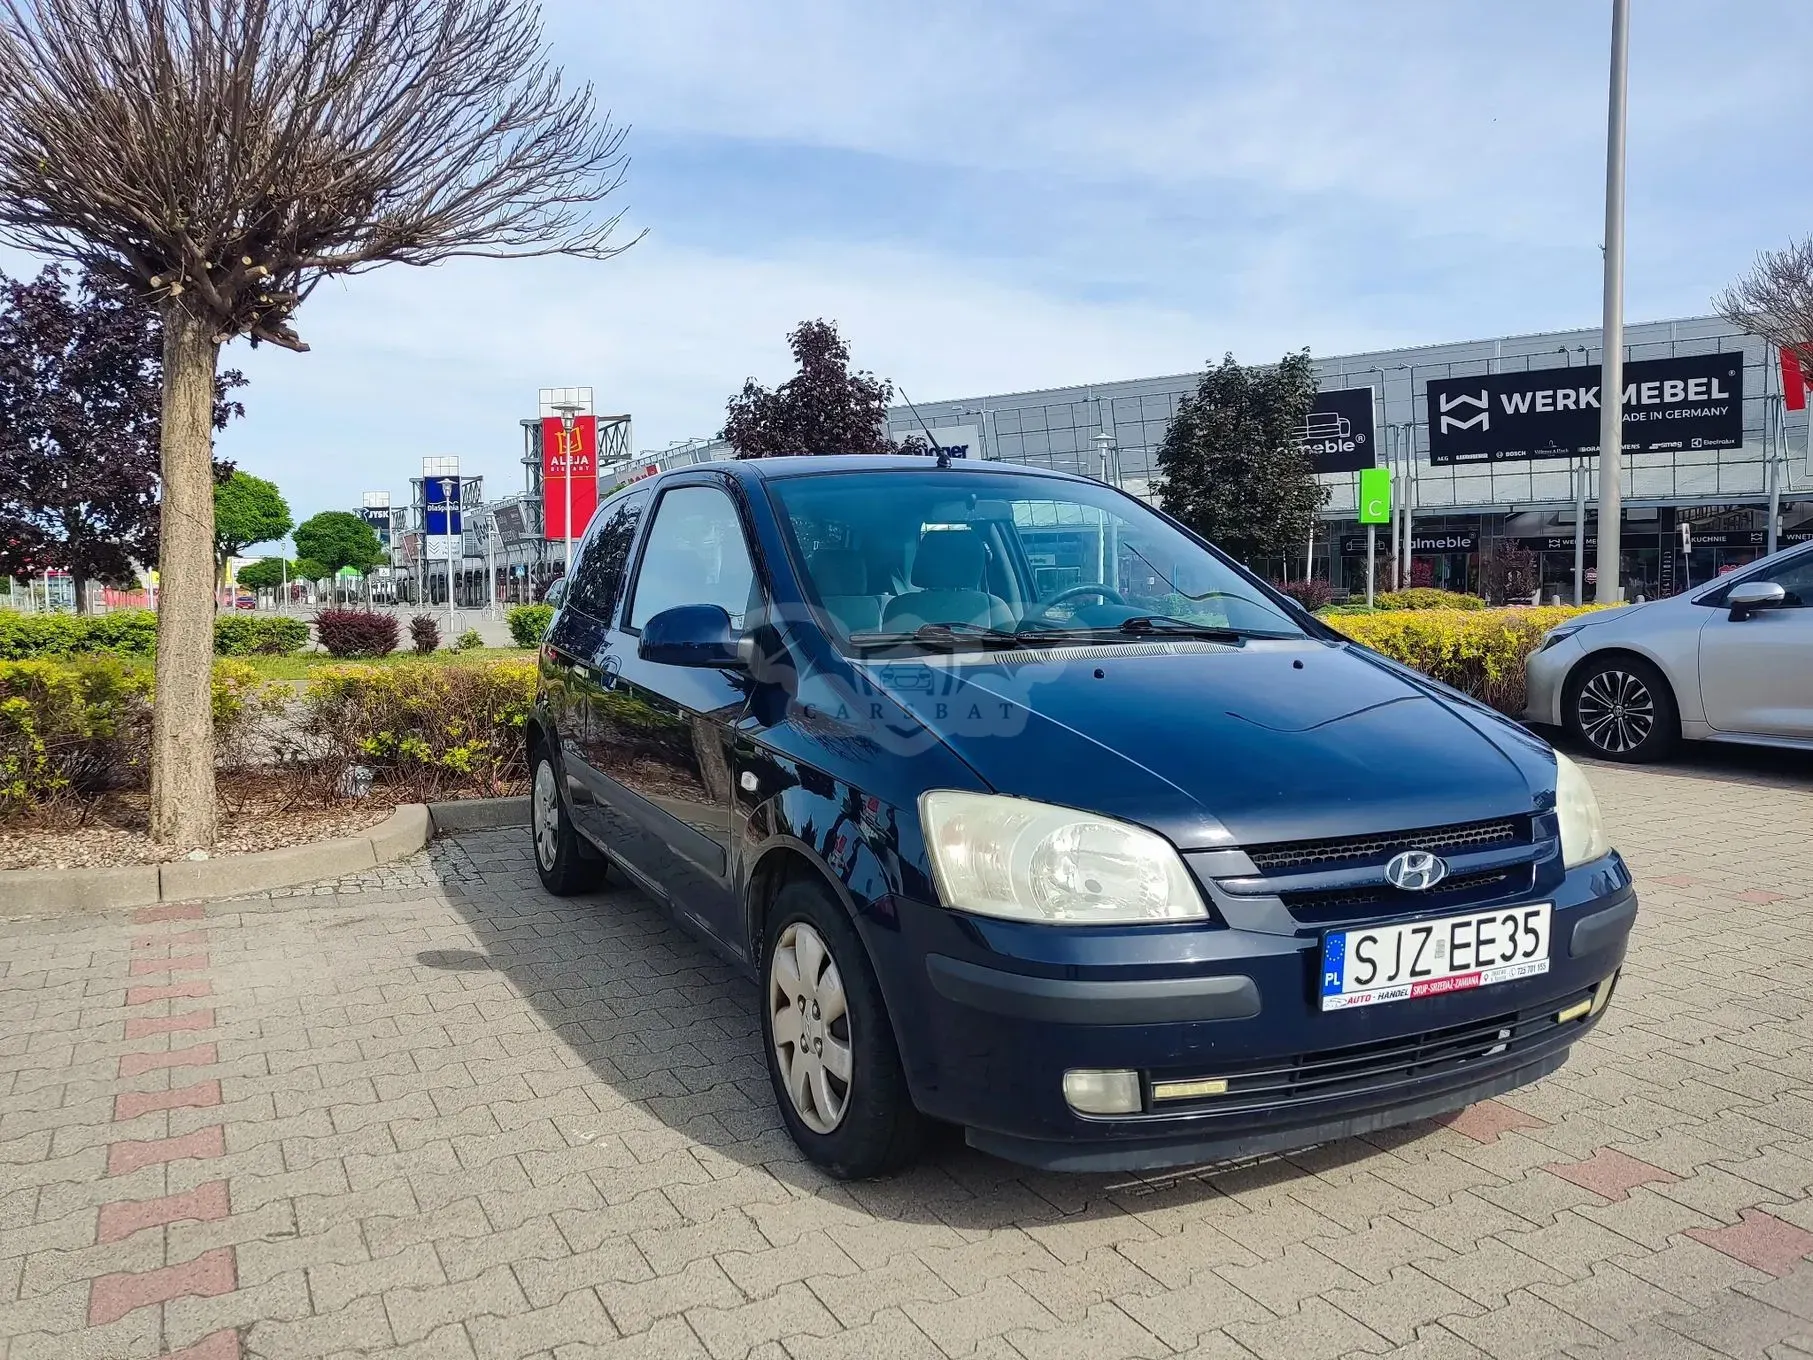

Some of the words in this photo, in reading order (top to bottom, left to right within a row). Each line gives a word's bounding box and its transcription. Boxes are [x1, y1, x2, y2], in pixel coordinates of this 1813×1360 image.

[1500, 387, 1600, 415] WERK
[1620, 377, 1729, 406] MEBEL
[1621, 410, 1647, 422] ADE
[1650, 410, 1663, 420] IN
[1665, 406, 1729, 419] GERMANY
[1703, 438, 1735, 446] Electrolux
[550, 455, 589, 466] ALEJA
[1505, 450, 1527, 458] BOSCH
[368, 510, 390, 519] JYSK
[1368, 500, 1383, 517] C
[1410, 536, 1471, 549] almeble
[1691, 535, 1727, 543] KUCHNIE
[1786, 533, 1813, 541] WNĘT
[1354, 925, 1433, 985] SJZ
[1449, 910, 1541, 971] EE35
[1324, 972, 1341, 987] PL
[1347, 994, 1372, 1005] AUTO
[1377, 988, 1410, 1001] HANDEL
